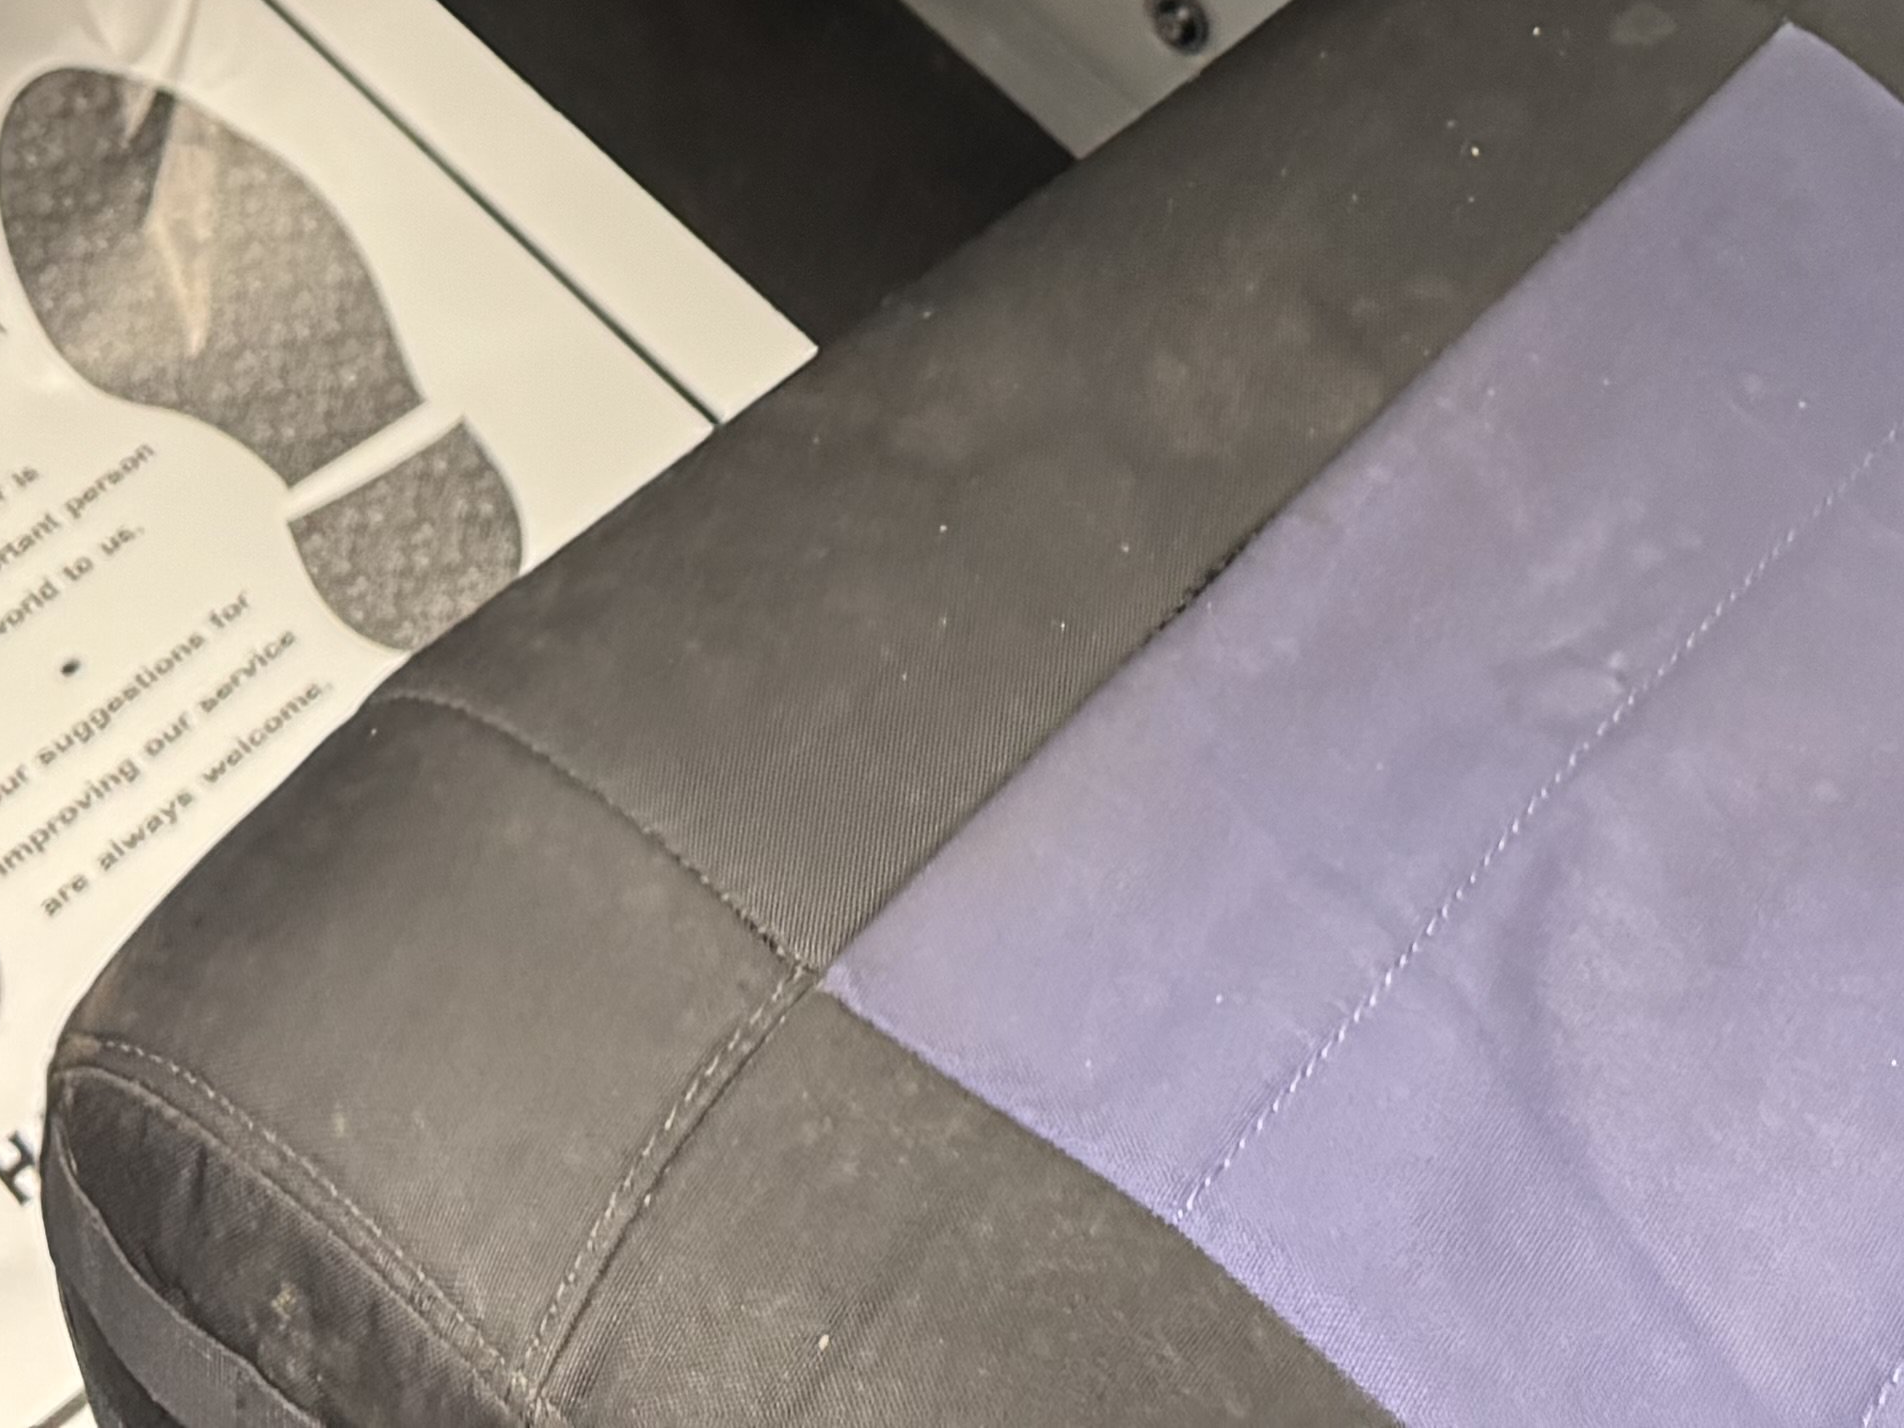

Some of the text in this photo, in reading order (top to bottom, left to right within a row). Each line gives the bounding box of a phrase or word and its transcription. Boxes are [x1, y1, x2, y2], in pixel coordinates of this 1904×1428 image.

[11, 464, 39, 489] is
[65, 443, 157, 520] person
[62, 554, 95, 583] to
[100, 525, 145, 557] us.
[36, 632, 206, 767] suggestions
[209, 589, 252, 630] for
[143, 711, 193, 758] our
[198, 630, 298, 715] service
[41, 872, 89, 917] are
[96, 788, 194, 872] always
